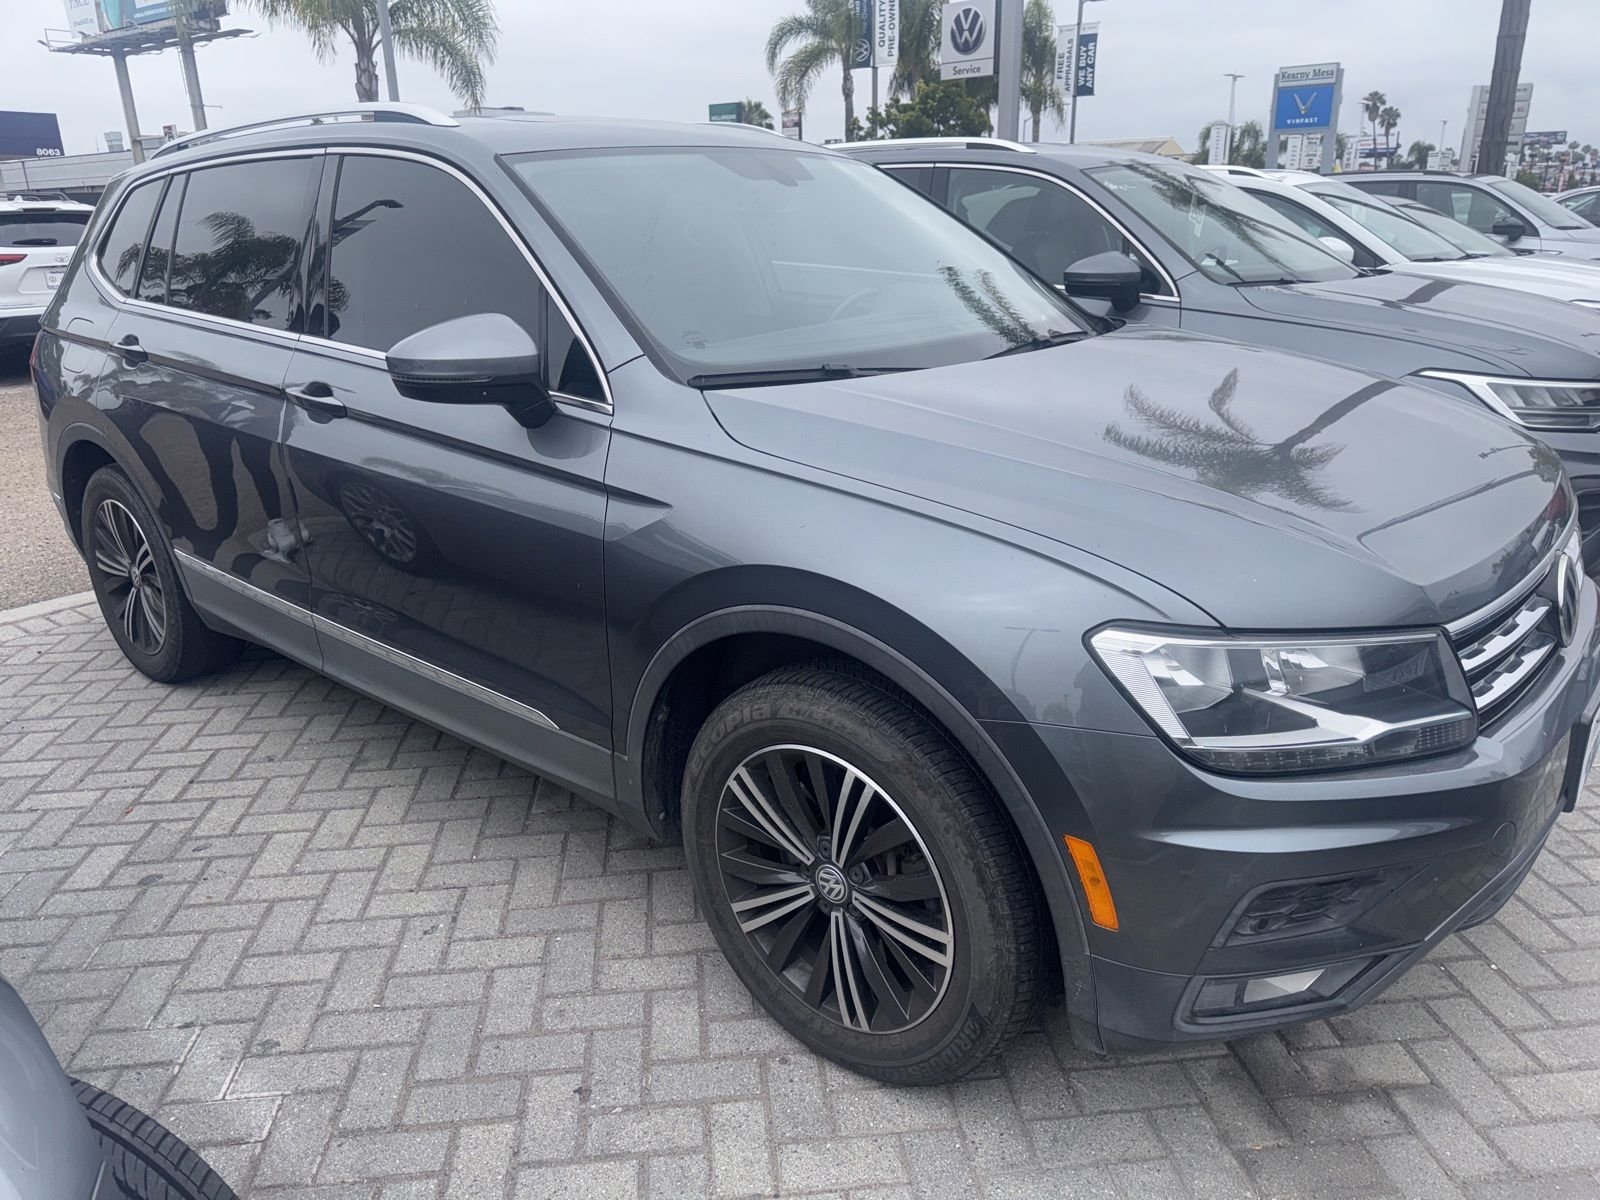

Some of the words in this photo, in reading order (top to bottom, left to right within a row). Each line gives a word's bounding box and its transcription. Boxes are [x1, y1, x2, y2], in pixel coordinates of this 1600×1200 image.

[878, 0, 886, 48] QUALITY
[1079, 46, 1087, 67] BUY
[1087, 42, 1096, 64] CAR
[952, 65, 982, 76] Service
[1056, 52, 1065, 80] FREE
[1064, 38, 1074, 92] APPRAISALS
[1281, 71, 1311, 80] Kearny
[1312, 69, 1335, 78] Mesa
[1078, 69, 1086, 86] WE
[1085, 66, 1094, 88] ANY
[1286, 117, 1319, 125] VINFAST
[36, 148, 61, 156] 8063
